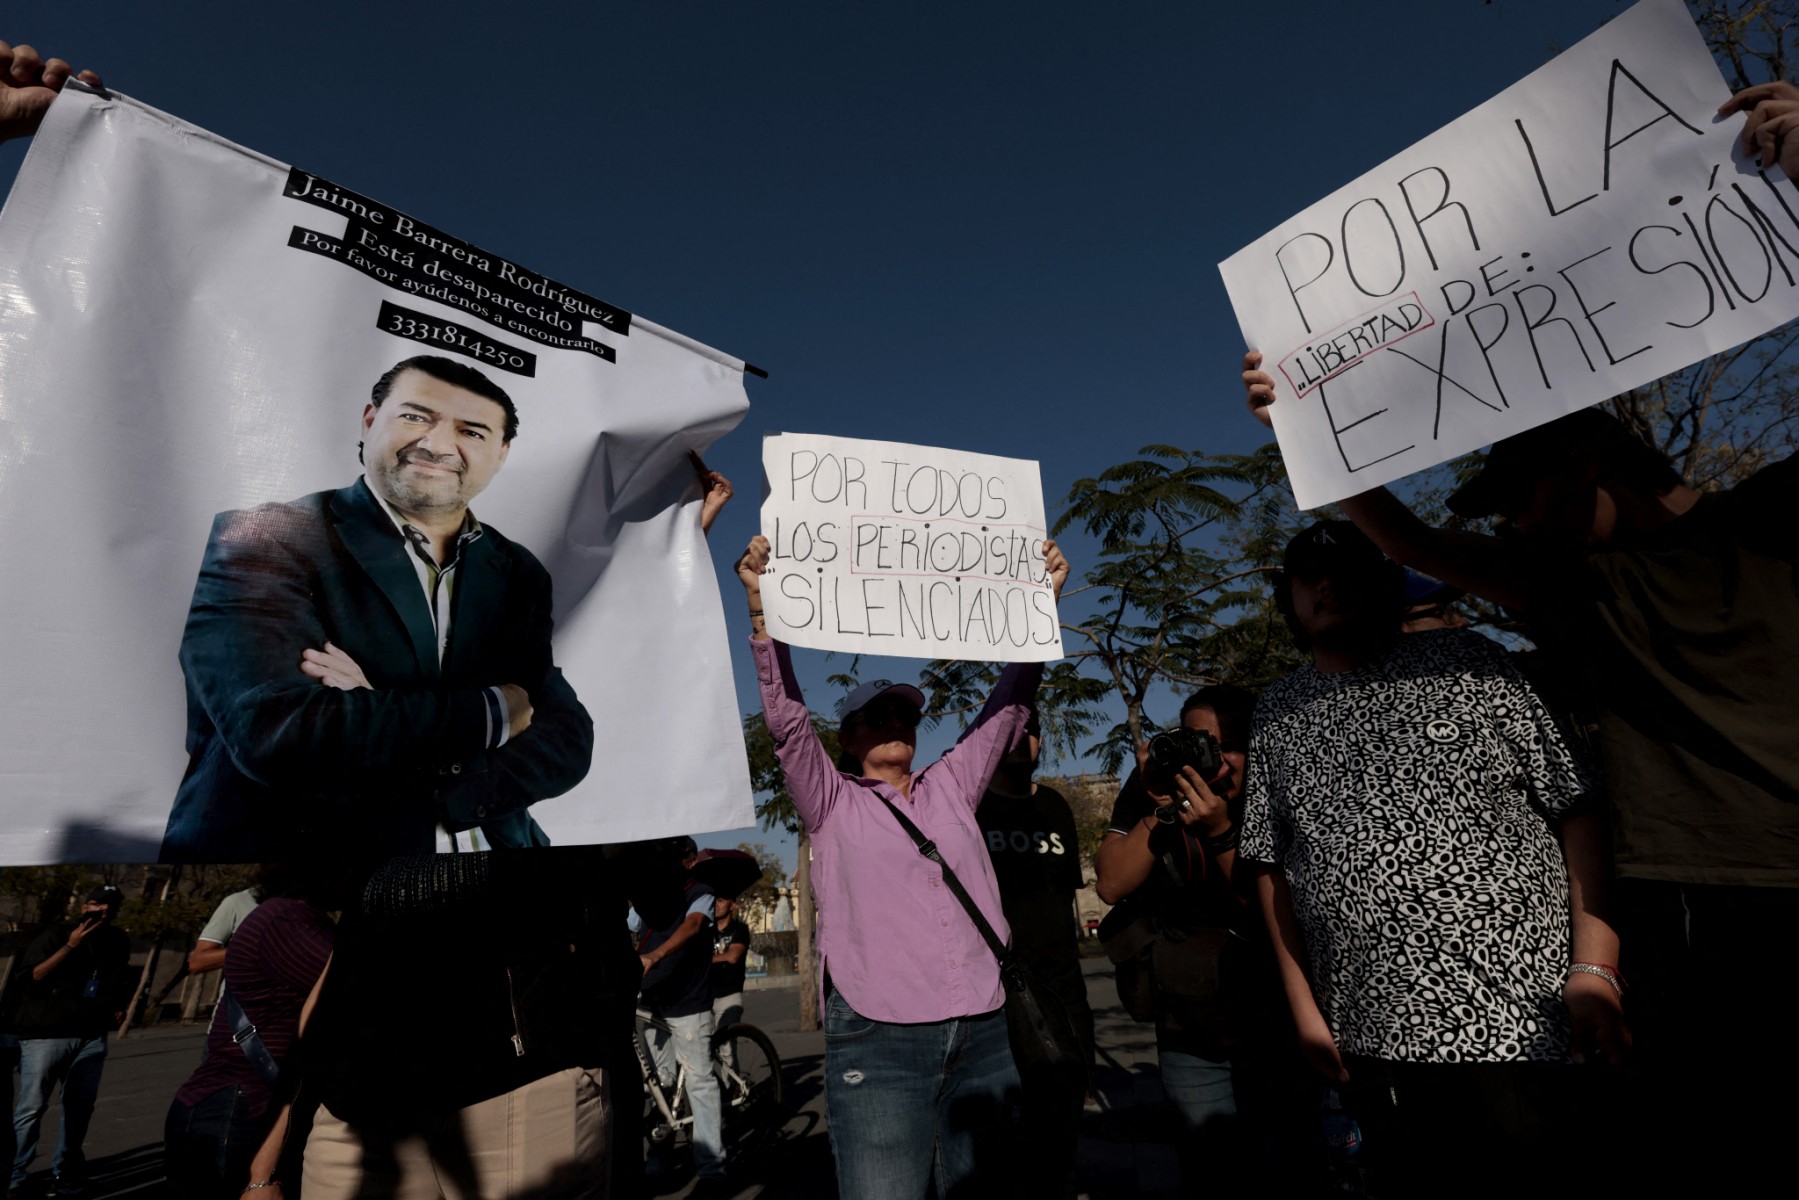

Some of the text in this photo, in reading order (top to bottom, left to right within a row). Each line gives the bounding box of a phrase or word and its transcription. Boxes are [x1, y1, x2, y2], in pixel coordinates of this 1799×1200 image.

[1276, 59, 1704, 333] POR LA
[292, 175, 615, 325] Jaime Barrera Rodríguez
[301, 231, 605, 355] Por favor ayúdenos a encontrarlo
[357, 227, 573, 332] Está desaparecido
[389, 314, 525, 368] 3331814250
[791, 450, 1007, 519] POR TODOS
[776, 517, 1047, 584] LOS PERIODISTAS
[987, 830, 1065, 856] BOSS
